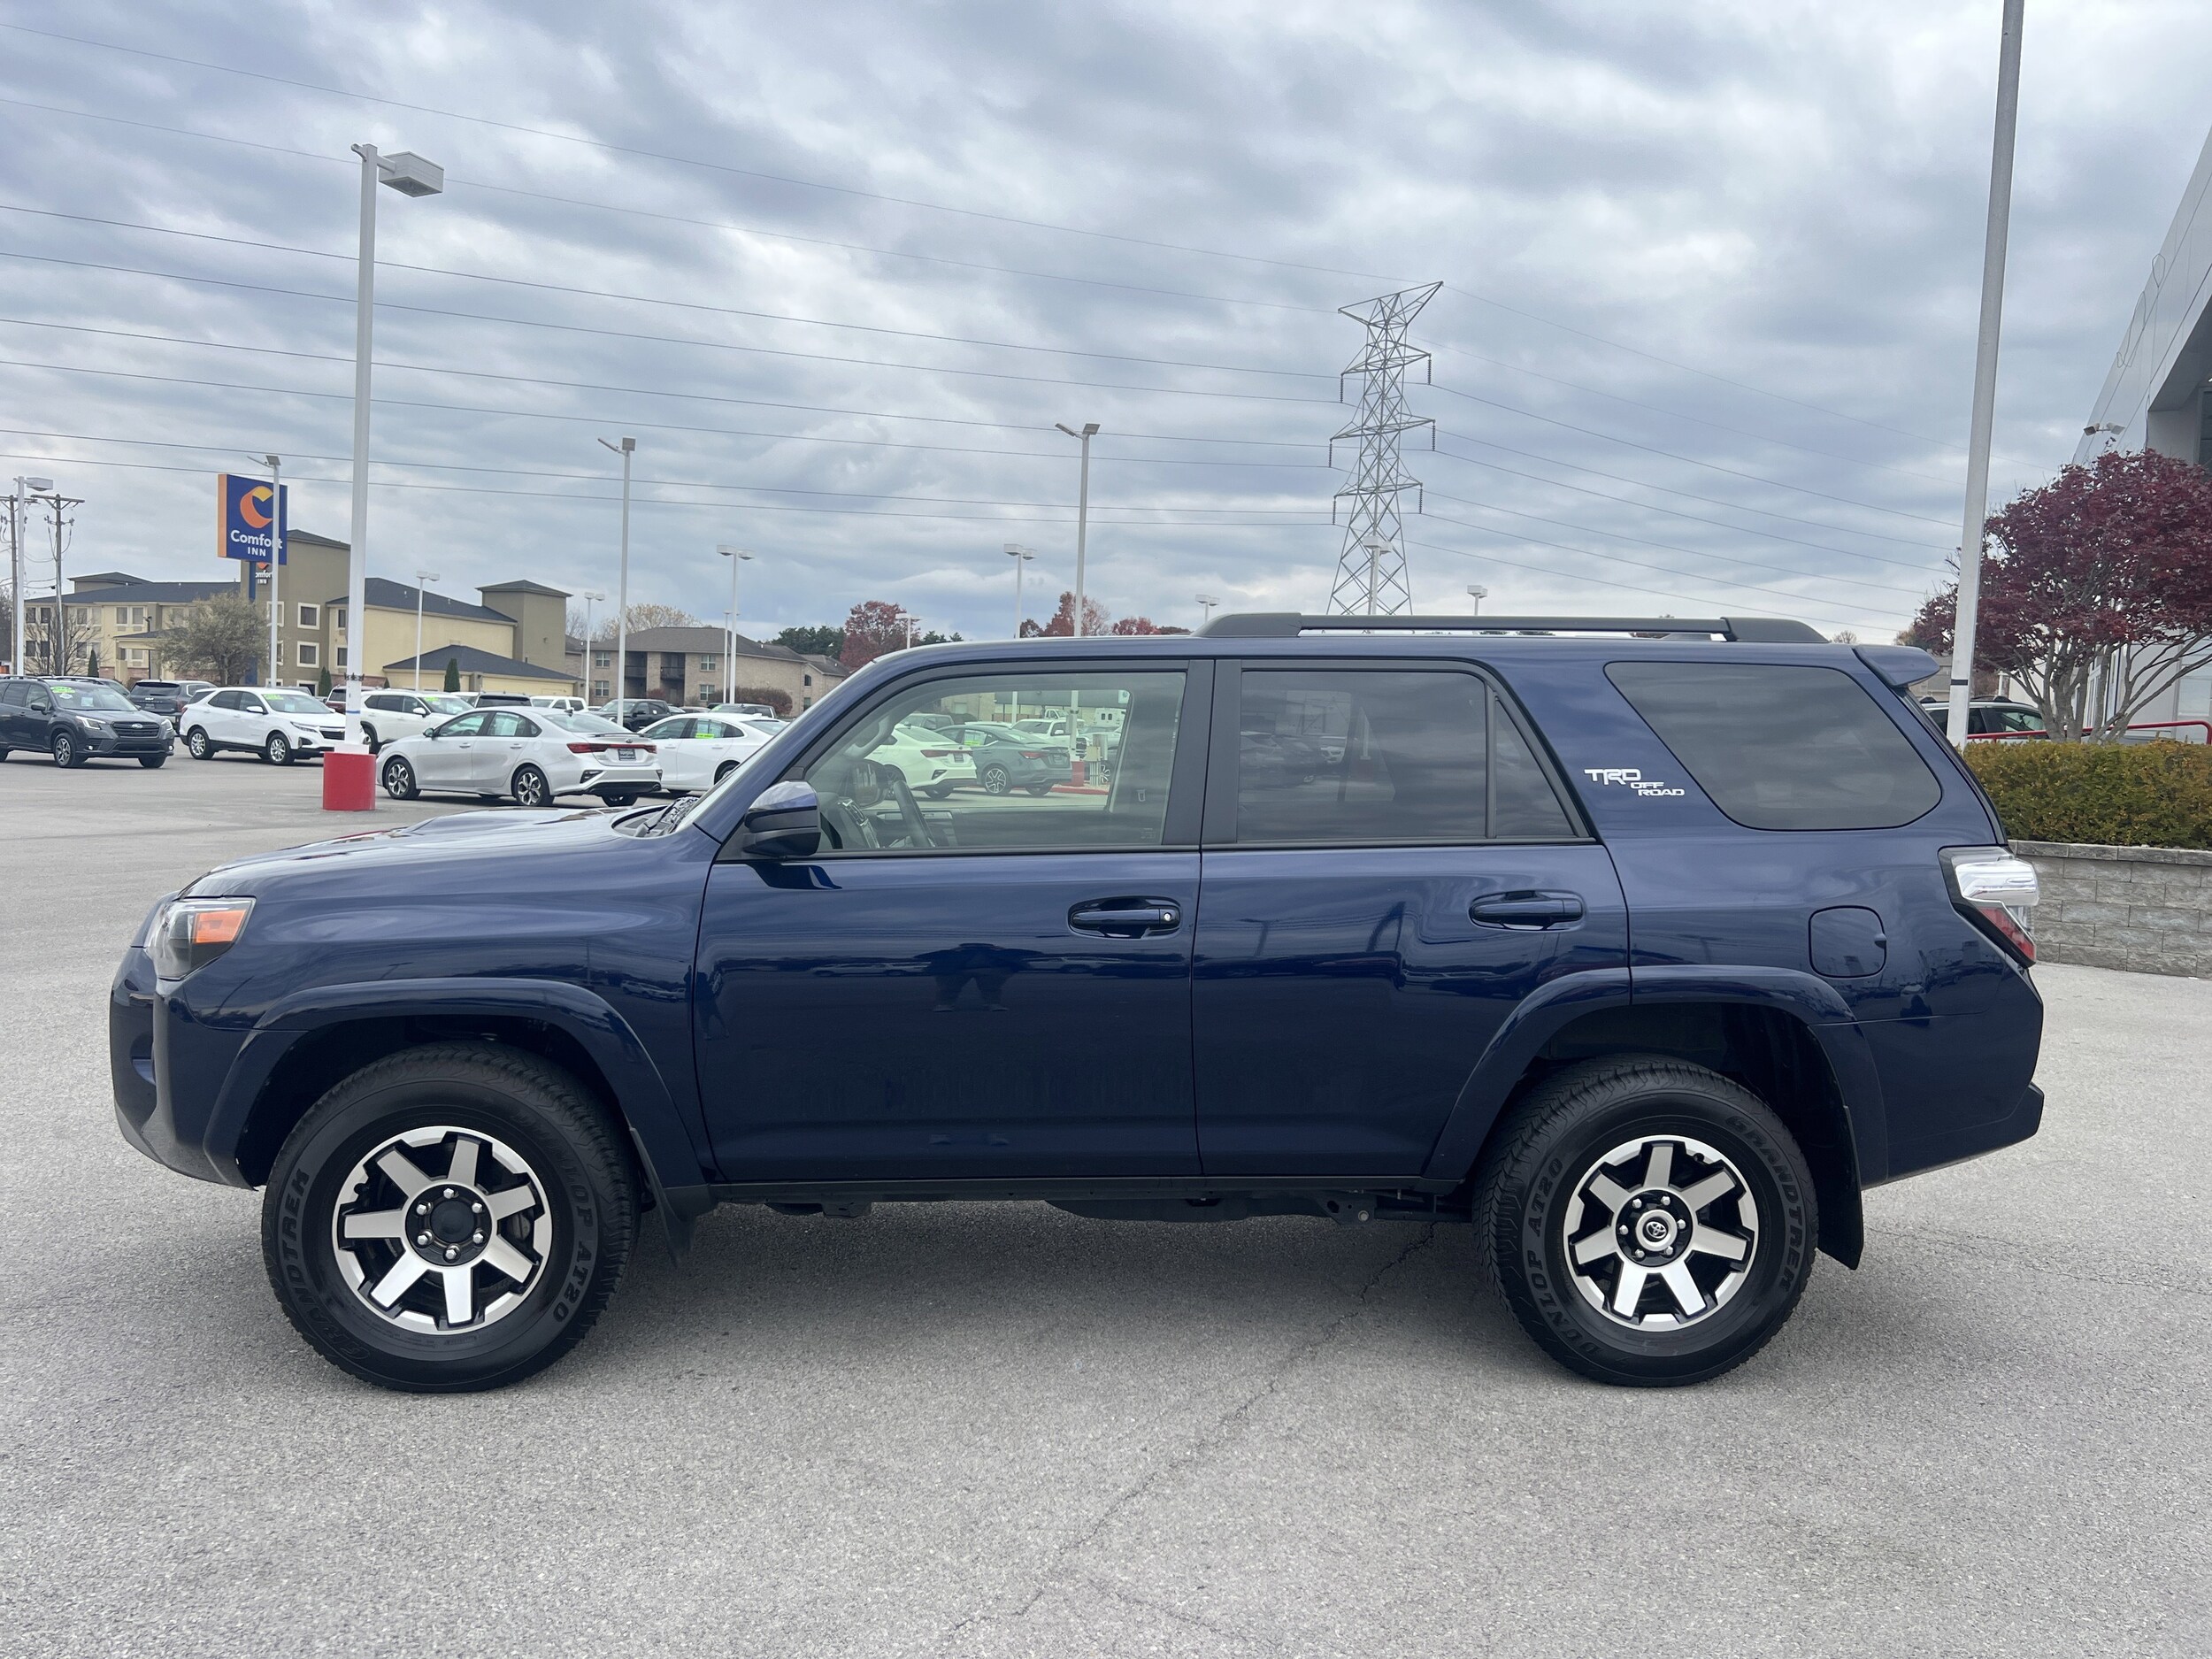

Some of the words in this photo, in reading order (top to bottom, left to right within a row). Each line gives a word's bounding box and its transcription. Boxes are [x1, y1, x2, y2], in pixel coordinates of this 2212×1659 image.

[230, 529, 283, 549] Comfot
[248, 547, 266, 557] INN
[1584, 769, 1641, 785] TRD
[1527, 1157, 1563, 1238] AT20
[1725, 1115, 1803, 1292] GRANDTREK
[281, 1168, 371, 1360] GRANDTREK
[552, 1240, 592, 1322] AT20
[1526, 1249, 1603, 1355] DUNLOP
